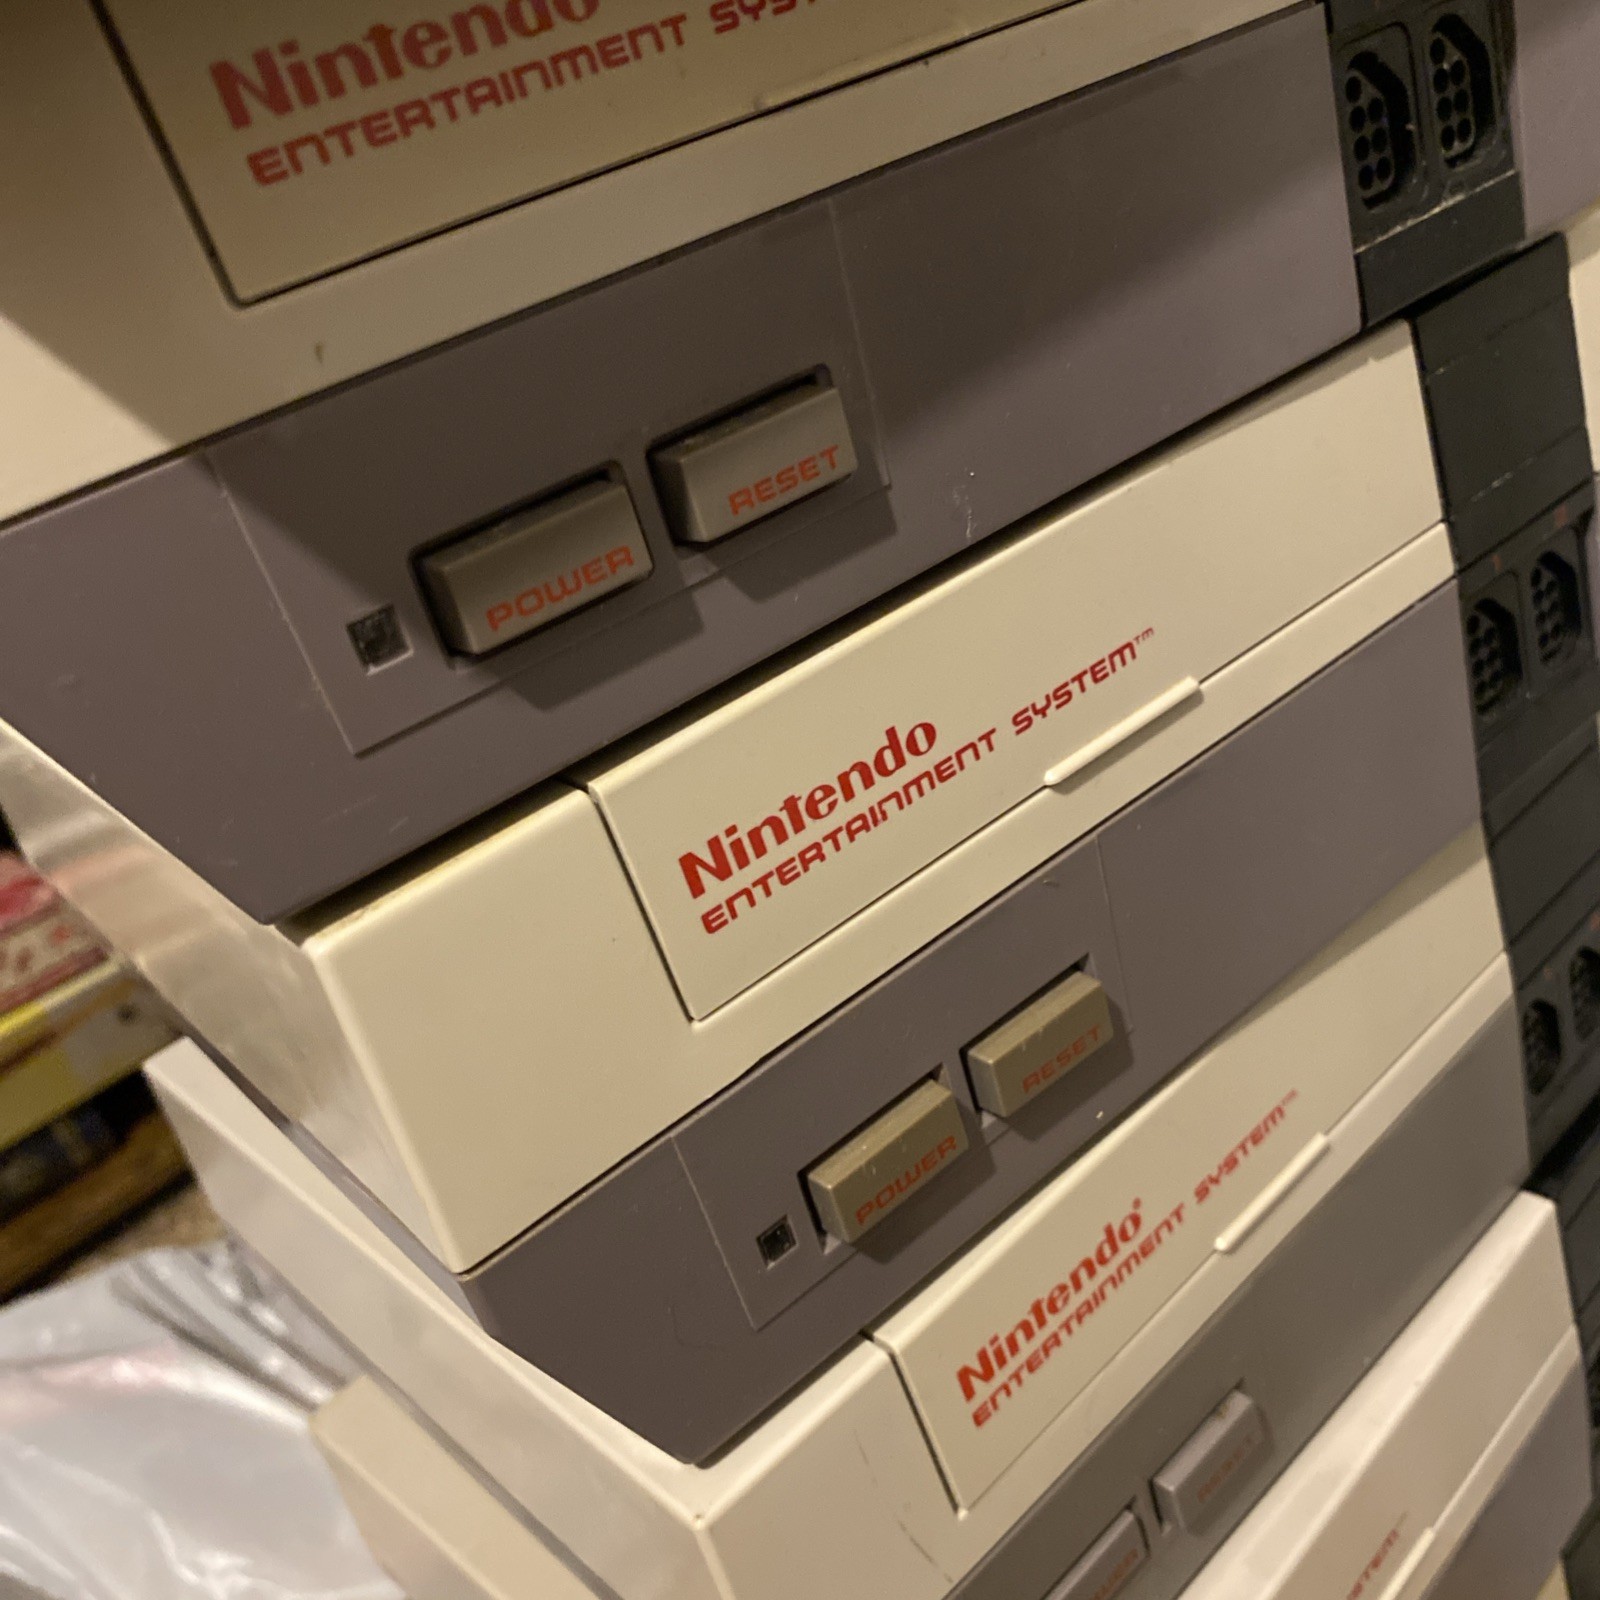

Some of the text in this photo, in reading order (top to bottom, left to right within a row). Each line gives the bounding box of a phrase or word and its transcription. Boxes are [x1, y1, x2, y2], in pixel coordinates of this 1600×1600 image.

[211, 0, 600, 129] Nintendo
[248, 0, 806, 185] ENTERTAINMENT SYS
[728, 445, 839, 517] RESET
[485, 545, 635, 632] POWER
[678, 720, 938, 901] Nintendo
[701, 727, 998, 936] ENTERTAINMENT
[1022, 1025, 1102, 1095] RESET
[855, 1135, 958, 1227] POWER
[972, 1203, 1185, 1429] ENTERTAINMENT
